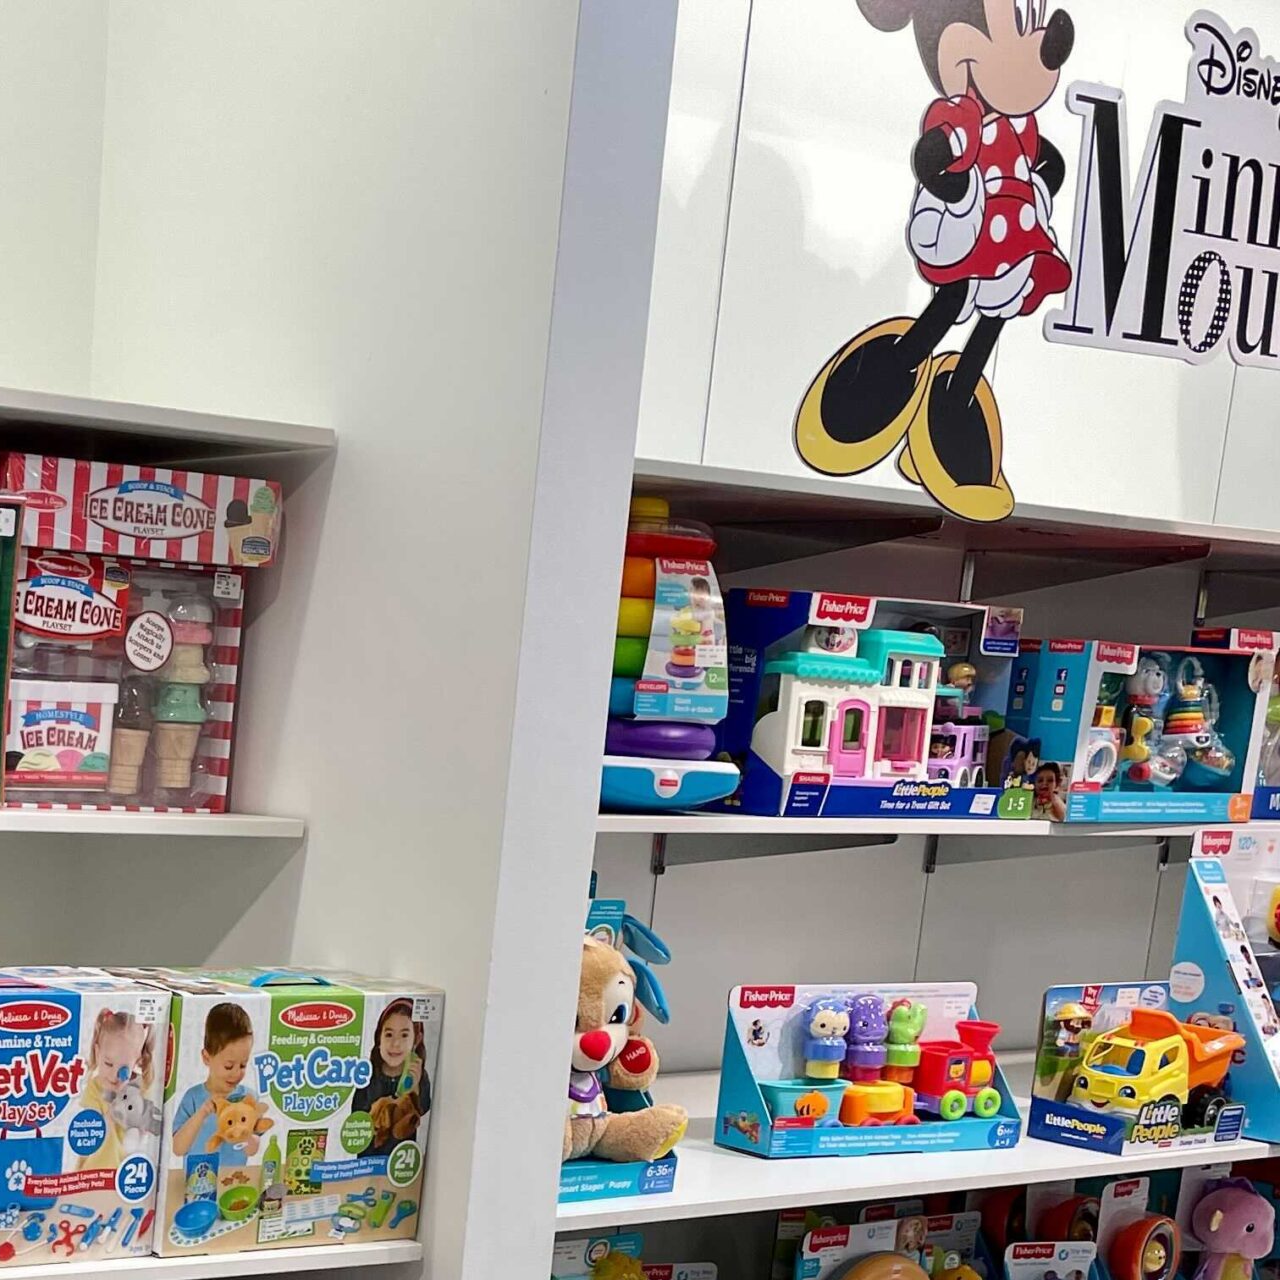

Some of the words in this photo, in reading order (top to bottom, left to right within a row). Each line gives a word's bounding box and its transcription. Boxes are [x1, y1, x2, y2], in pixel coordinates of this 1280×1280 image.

[83, 492, 108, 521] ICE
[112, 496, 166, 525] CREAM
[170, 501, 216, 531] CONE
[132, 525, 166, 536] PLAYSET
[23, 598, 78, 625] CREAM
[79, 602, 122, 630] CONE
[41, 620, 73, 632] PLAYSET
[20, 729, 44, 749] ICE
[46, 727, 99, 751] CREAM
[880, 799, 897, 811] Time
[1007, 797, 1025, 811] 1-5
[41, 1010, 65, 1025] Doug
[287, 1010, 321, 1024] Melissa
[329, 1009, 349, 1024] Doug
[44, 1035, 72, 1048] Treat
[271, 1034, 309, 1046] Feeding
[317, 1034, 361, 1047] Grooming
[625, 1045, 648, 1062] HAND
[28, 1053, 85, 1095] Vet
[254, 1053, 303, 1094] Pet
[307, 1049, 371, 1086] Care
[28, 1103, 55, 1120] Set
[284, 1095, 314, 1113] Play
[316, 1093, 340, 1109] Set
[1139, 1103, 1179, 1125] Little
[1130, 1122, 1180, 1143] People
[396, 1148, 416, 1170] 24
[123, 1161, 149, 1185] 24
[608, 1180, 632, 1192] Puppy
